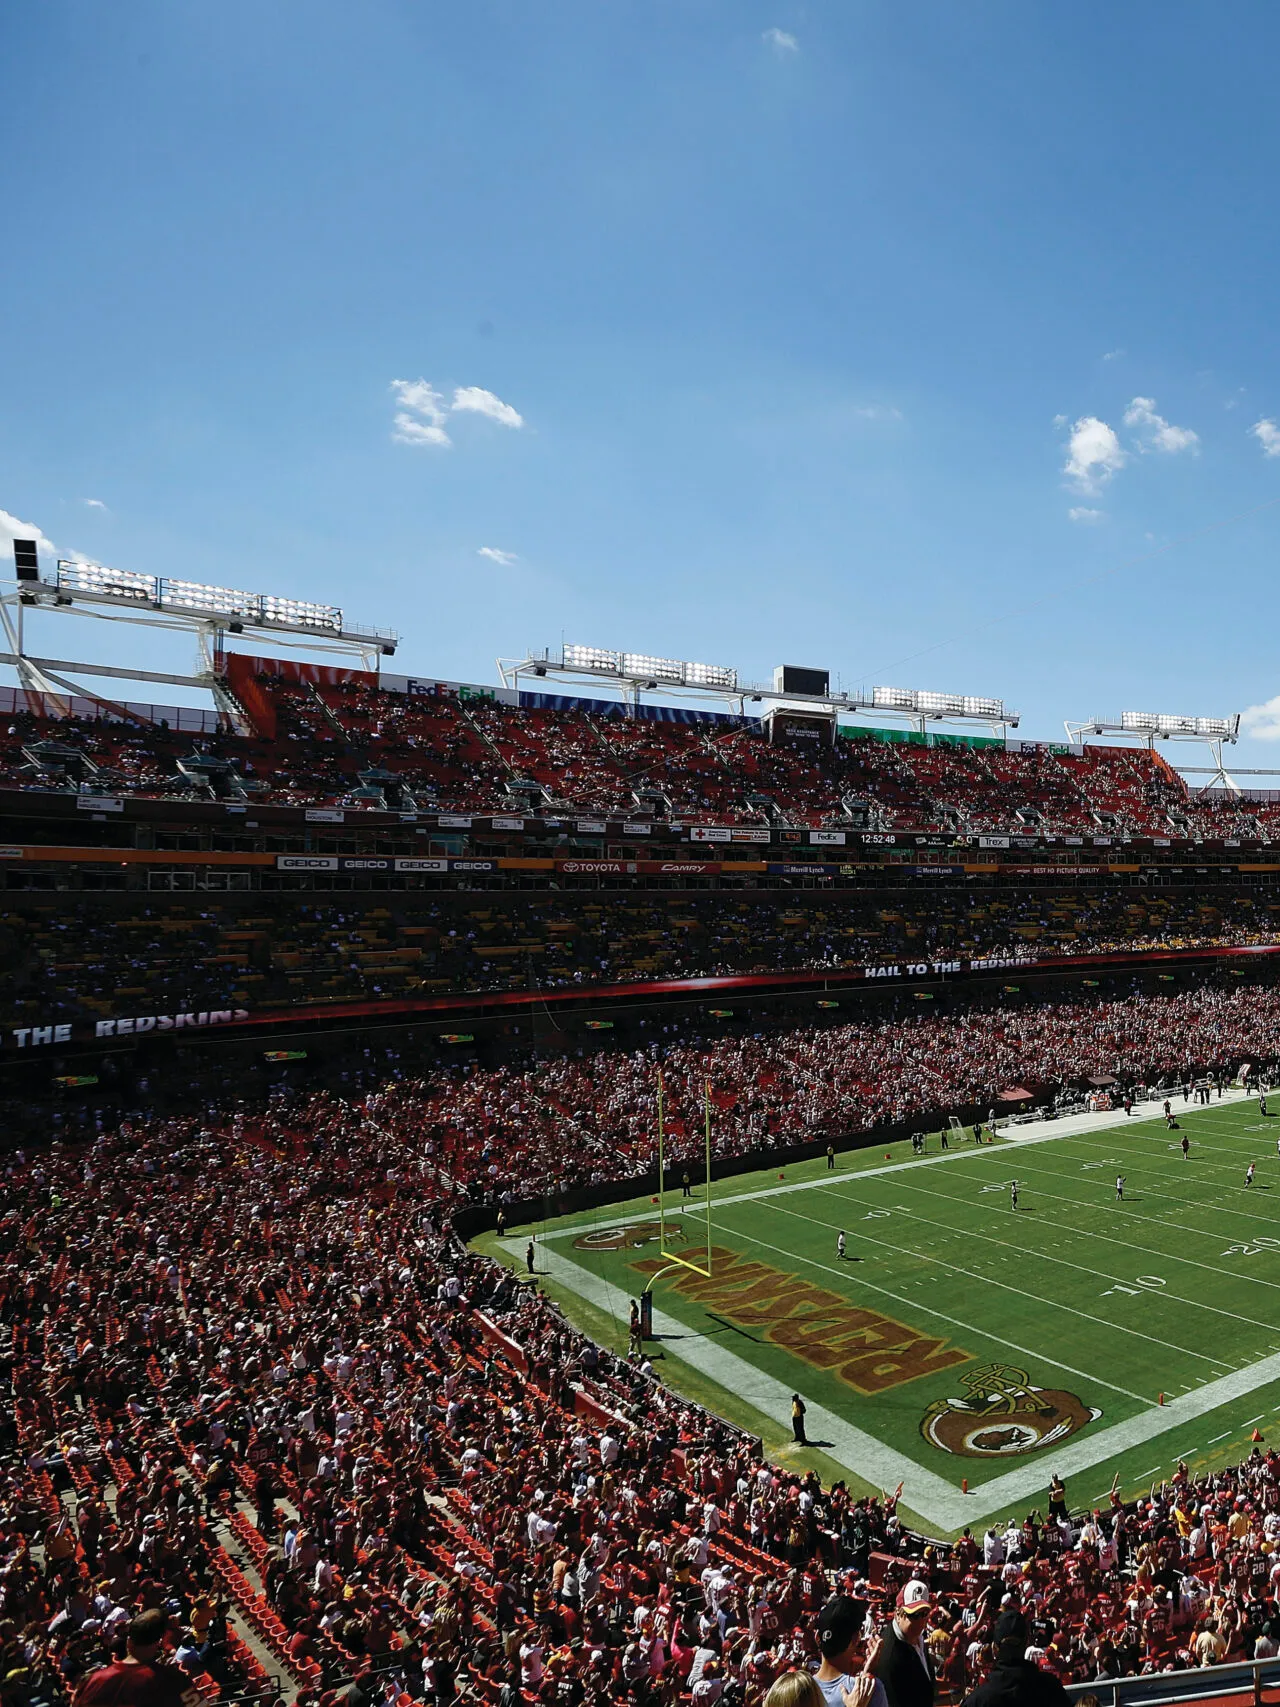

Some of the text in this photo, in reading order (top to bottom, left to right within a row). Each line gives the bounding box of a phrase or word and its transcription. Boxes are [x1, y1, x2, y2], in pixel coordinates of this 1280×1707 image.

[817, 832, 837, 841] FedEx
[860, 834, 896, 844] 12:52:48
[984, 837, 1004, 846] Trex
[284, 859, 330, 868] GEICO
[344, 860, 388, 869] GEICO
[400, 861, 441, 869] GEICO
[453, 862, 492, 870] GEICO
[579, 863, 621, 872] TOYOTA
[660, 864, 707, 872] CAMRY
[808, 866, 825, 875] Lynch
[864, 957, 1039, 978] HAIL TO THE REDSKINS
[12, 1008, 250, 1049] THE REDSKINS
[1112, 1274, 1168, 1297] 10
[1252, 1562, 1265, 1576] 28
